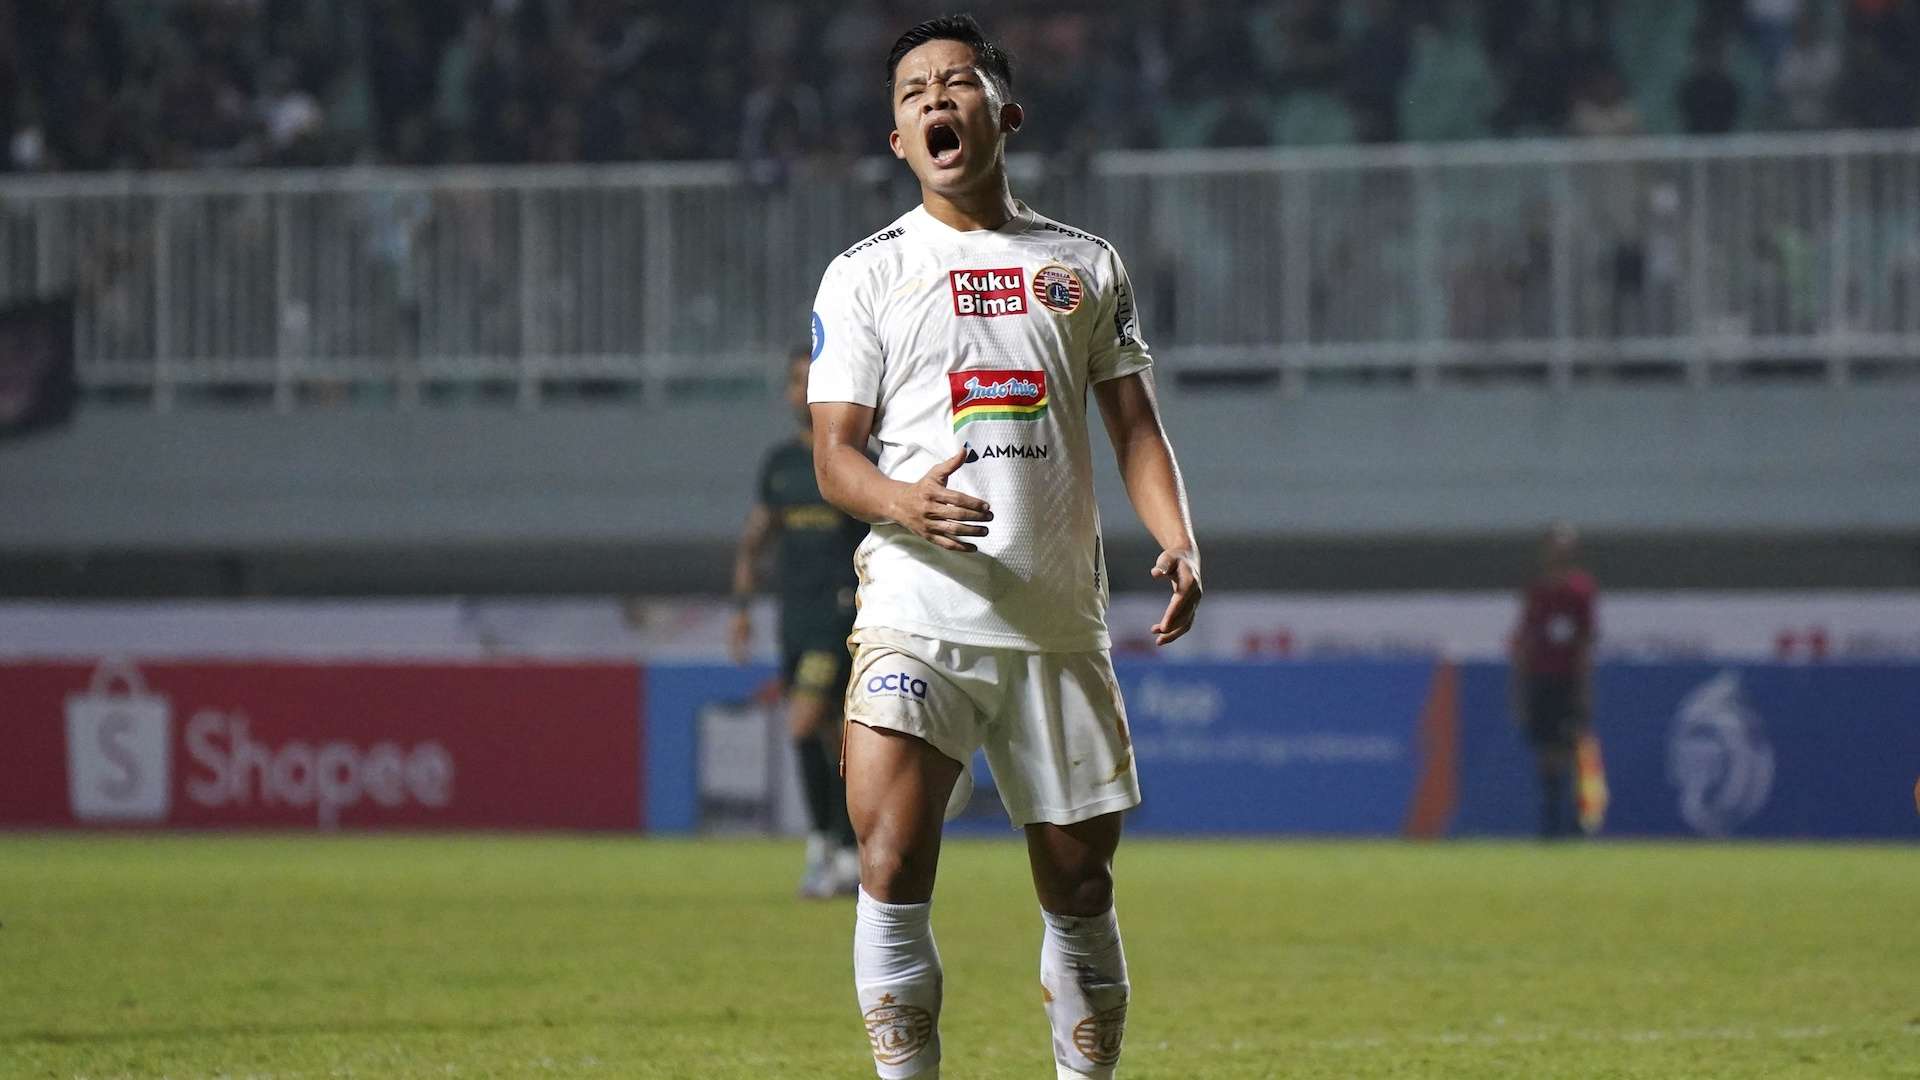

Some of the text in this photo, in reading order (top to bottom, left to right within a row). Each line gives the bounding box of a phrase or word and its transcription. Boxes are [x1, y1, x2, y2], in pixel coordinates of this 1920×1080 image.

[953, 271, 1020, 292] Kuku
[1042, 270, 1071, 280] PERSIJA
[957, 293, 1024, 315] Bima
[982, 445, 1047, 459] AMMAN
[867, 672, 928, 699] octa
[185, 709, 454, 831] Shopee
